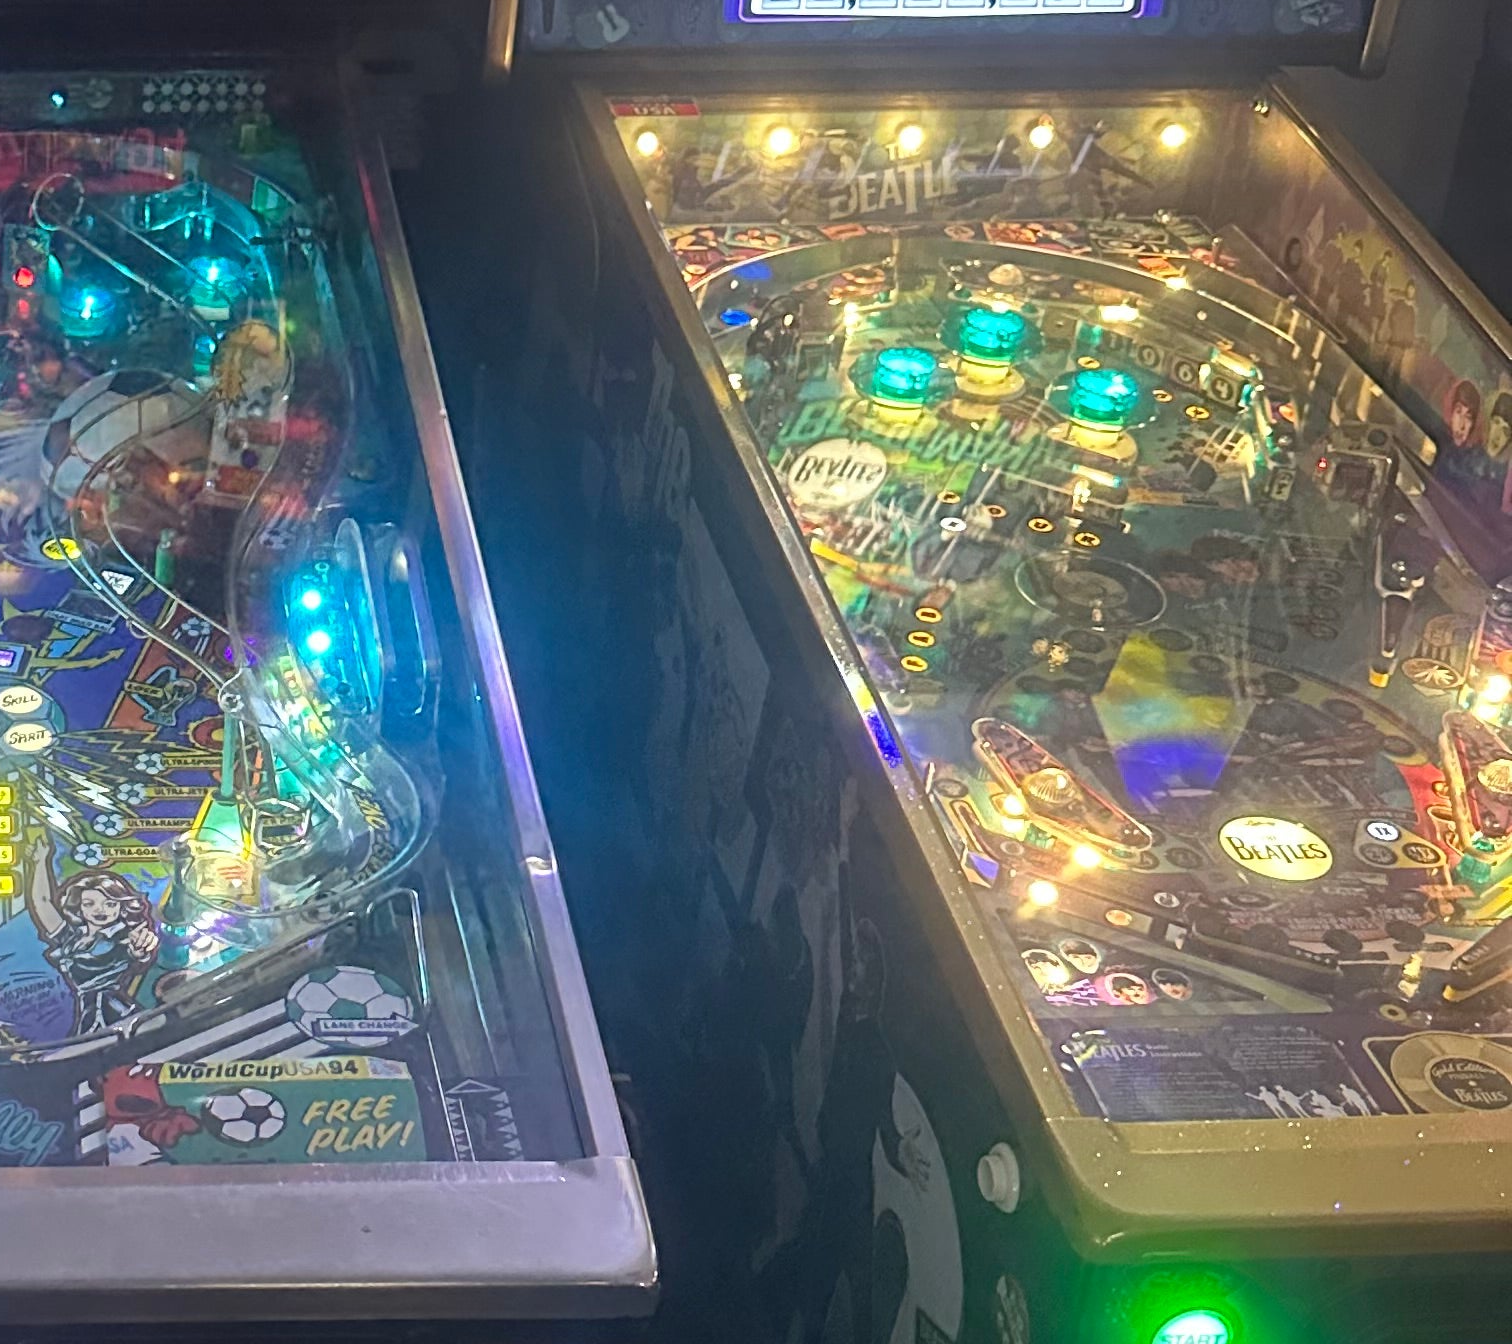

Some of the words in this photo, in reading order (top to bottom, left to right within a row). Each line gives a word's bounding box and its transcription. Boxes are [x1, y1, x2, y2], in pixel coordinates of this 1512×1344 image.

[633, 105, 677, 117] USA
[127, 683, 158, 695] LOCK
[2, 693, 39, 707] SKILL
[1226, 836, 1328, 864] BEATLES
[324, 1021, 355, 1030] LANE
[357, 1021, 409, 1030] CHANGE
[169, 1060, 359, 1080] WorldCupUSA94
[1455, 1087, 1508, 1105] BEATLES
[302, 1094, 397, 1126] FREE
[107, 1135, 134, 1154] SA
[307, 1121, 416, 1156] PLAY!
